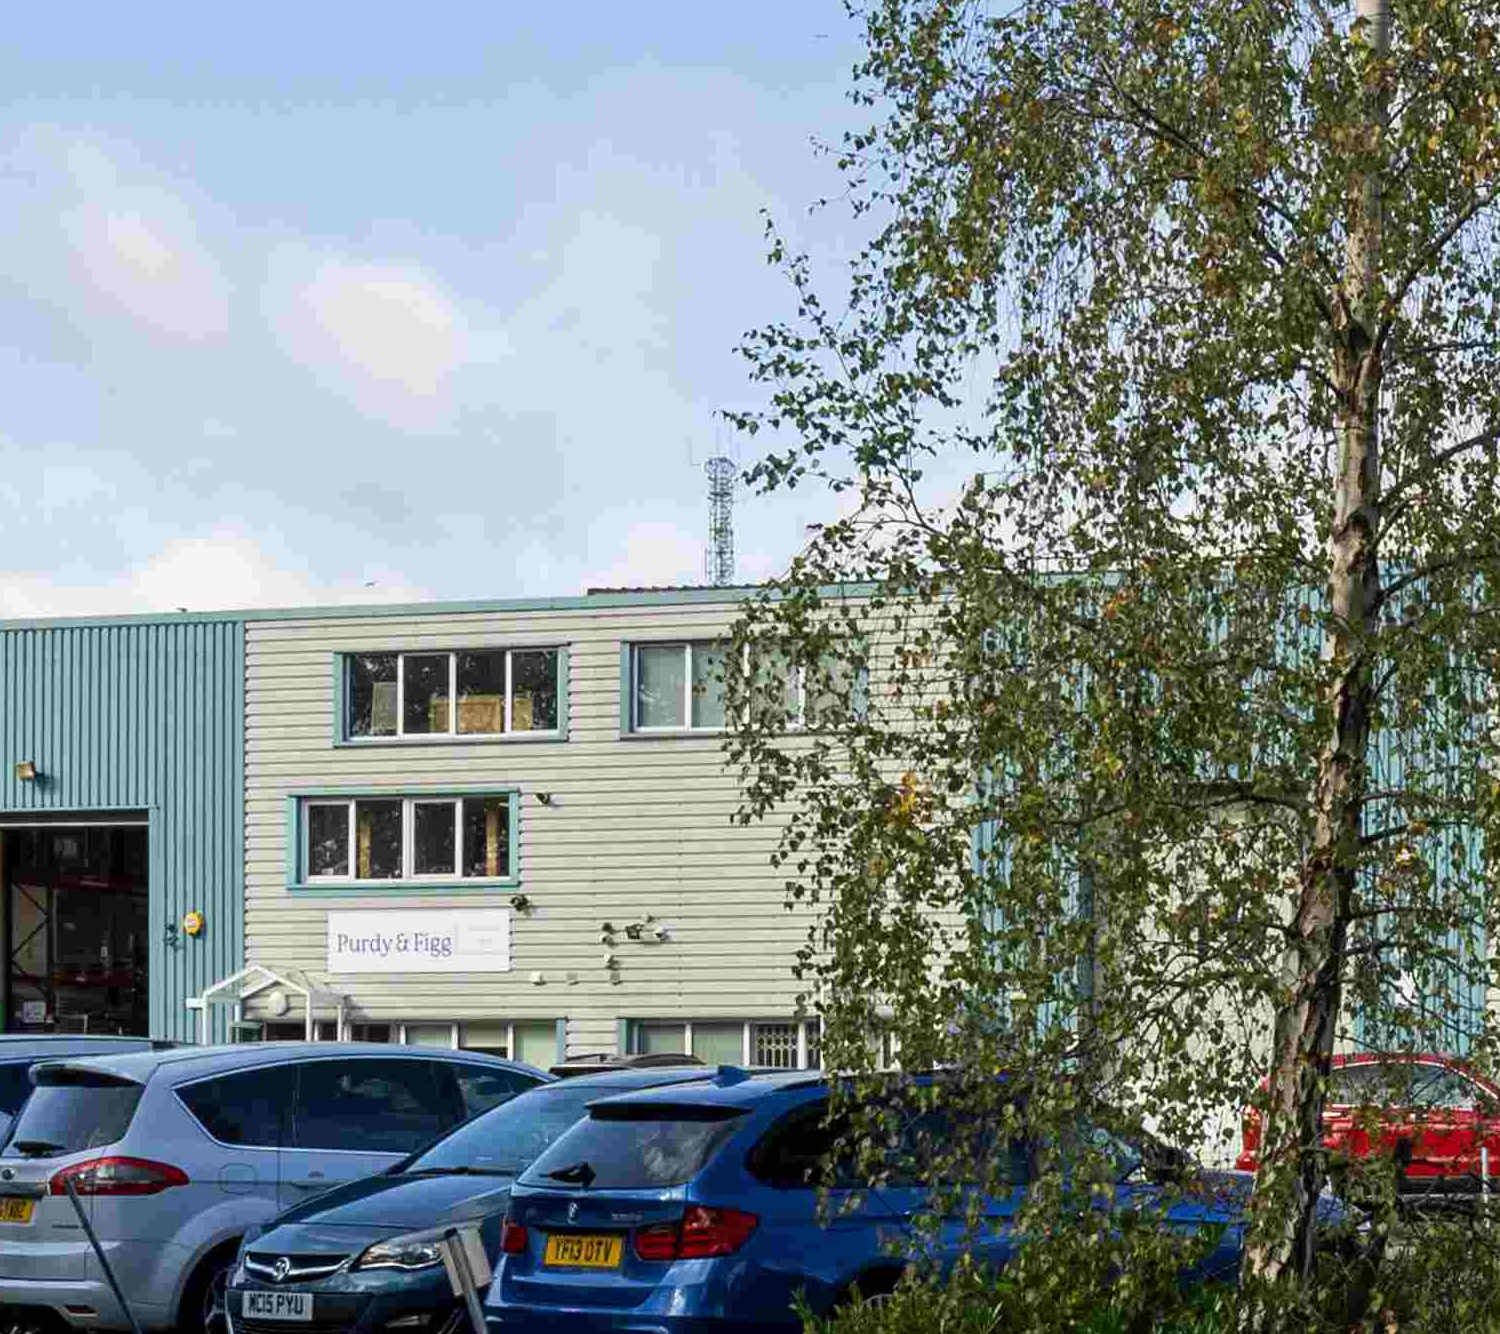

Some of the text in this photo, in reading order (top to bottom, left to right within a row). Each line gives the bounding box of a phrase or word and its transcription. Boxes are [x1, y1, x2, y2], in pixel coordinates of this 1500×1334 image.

[337, 933, 392, 957] Purdy
[396, 932, 408, 953] &
[414, 932, 453, 957] Figg
